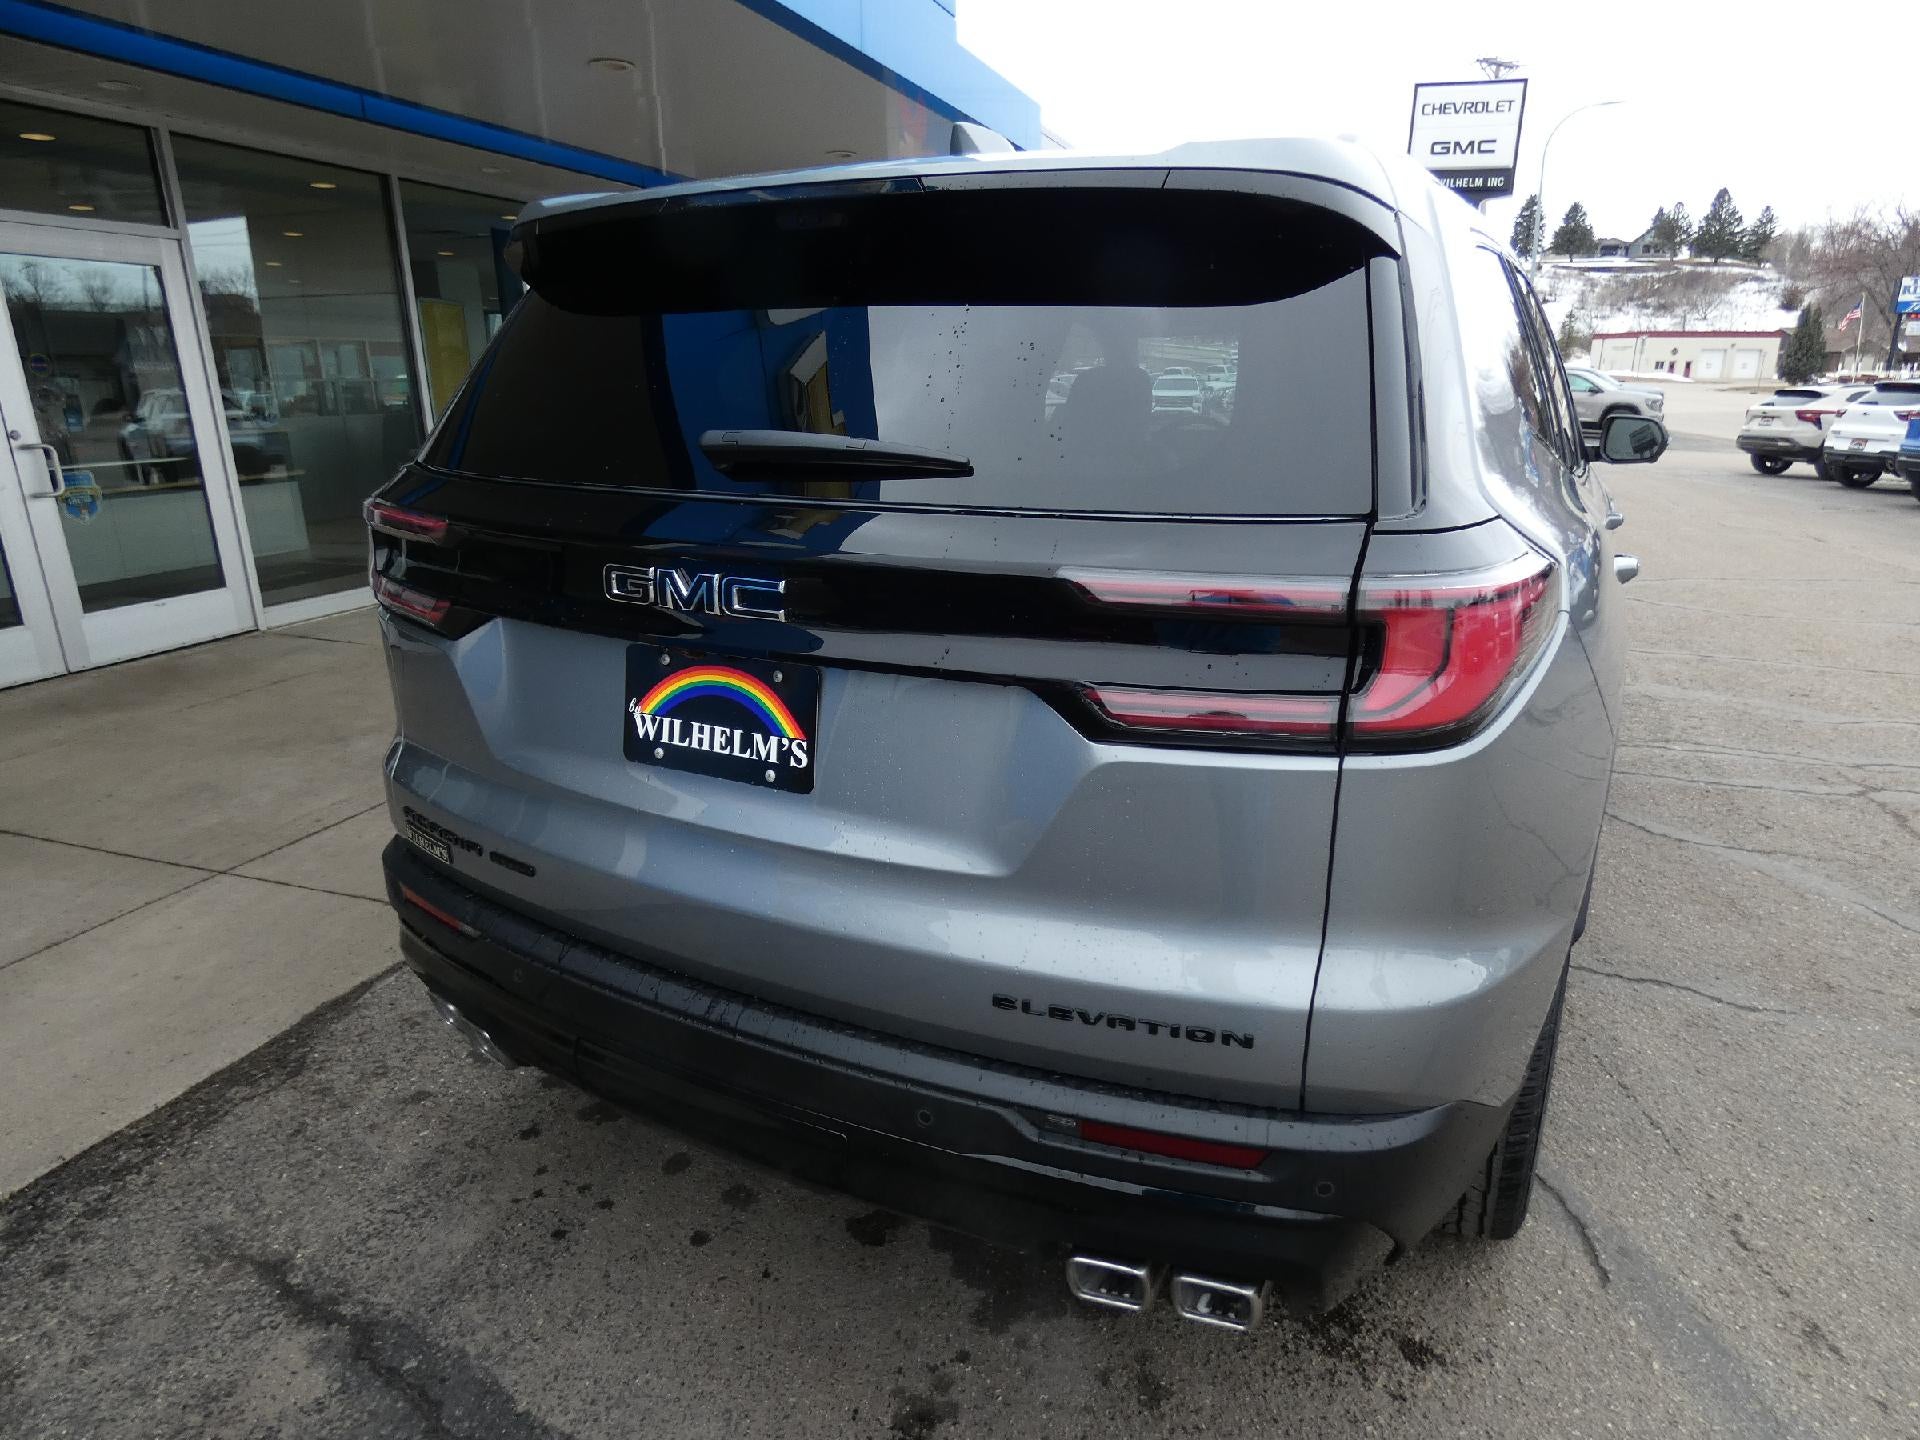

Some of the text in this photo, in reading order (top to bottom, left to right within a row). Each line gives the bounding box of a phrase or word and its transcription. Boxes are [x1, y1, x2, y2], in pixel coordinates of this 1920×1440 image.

[1421, 100, 1515, 116] CHEVROLET
[1429, 139, 1497, 155] GMC
[1487, 176, 1505, 187] INC
[602, 563, 787, 623] GMC
[633, 712, 808, 769] WILHELM'S
[992, 992, 1255, 1050] ELEVATION
